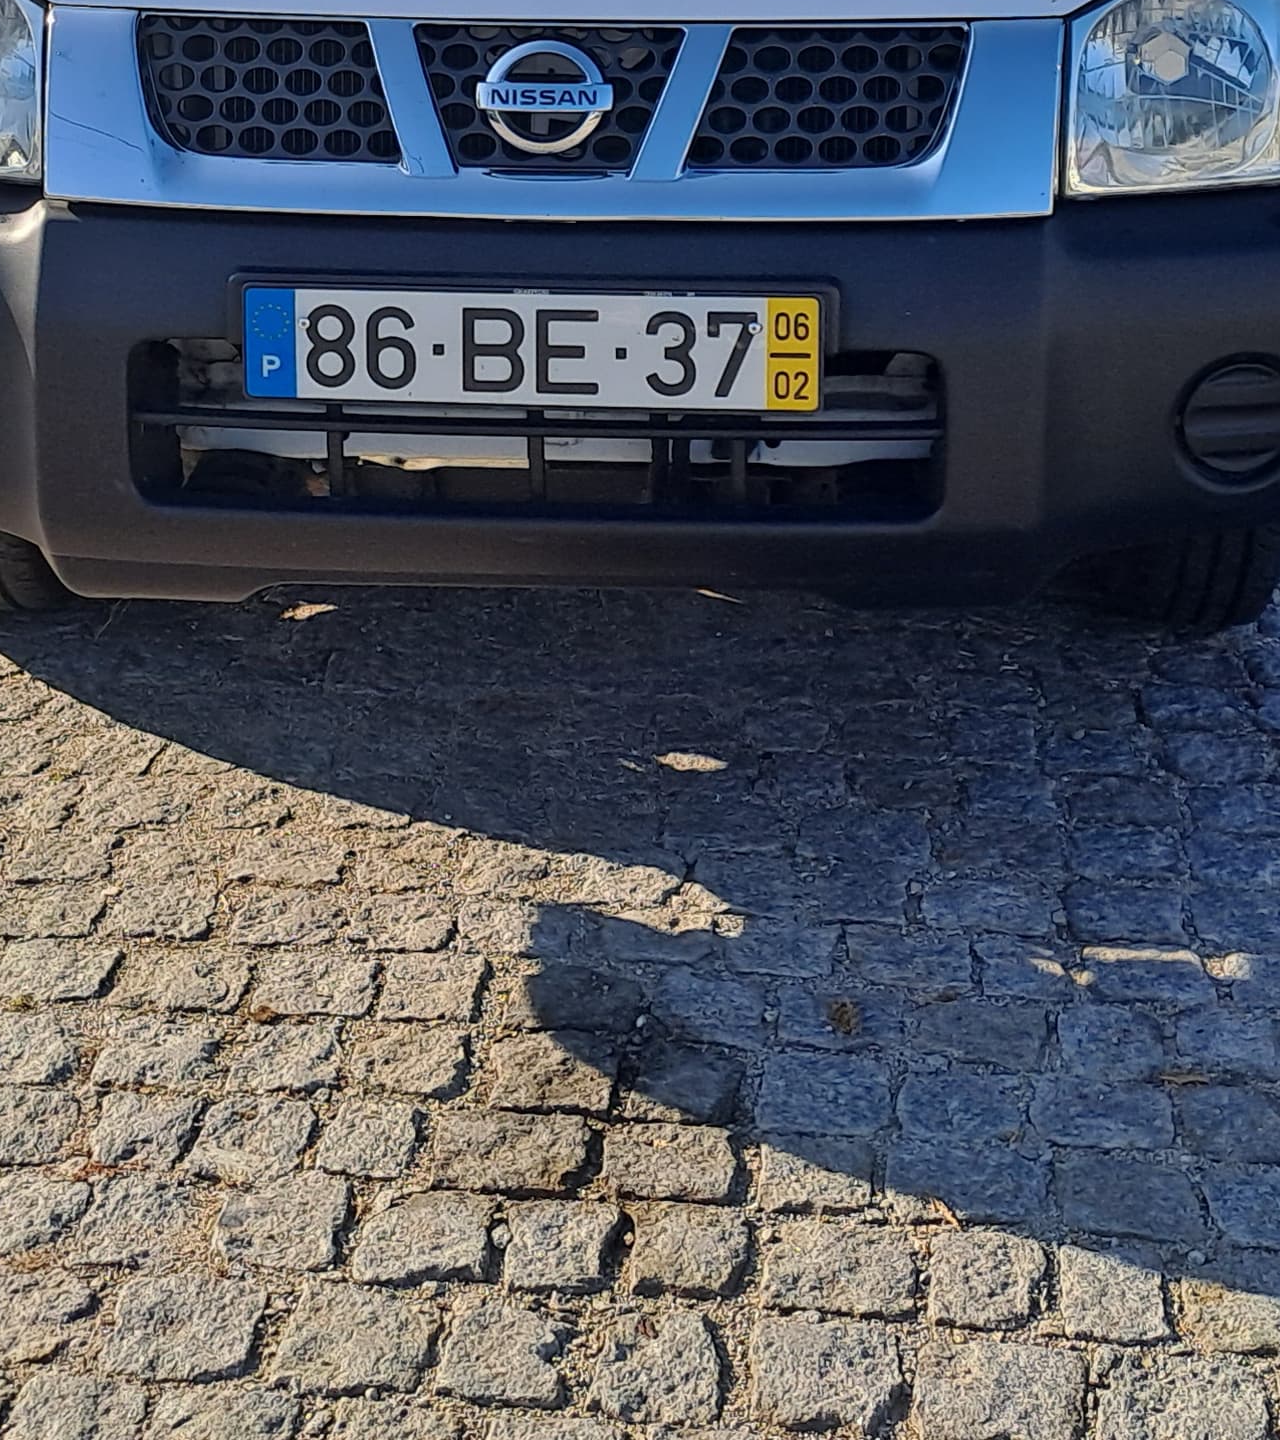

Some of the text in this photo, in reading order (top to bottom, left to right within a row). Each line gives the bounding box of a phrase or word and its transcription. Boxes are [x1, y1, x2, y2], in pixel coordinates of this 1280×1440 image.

[491, 89, 597, 106] NISSAN
[773, 311, 811, 342] 06
[262, 354, 281, 378] P
[773, 371, 811, 401] 02
